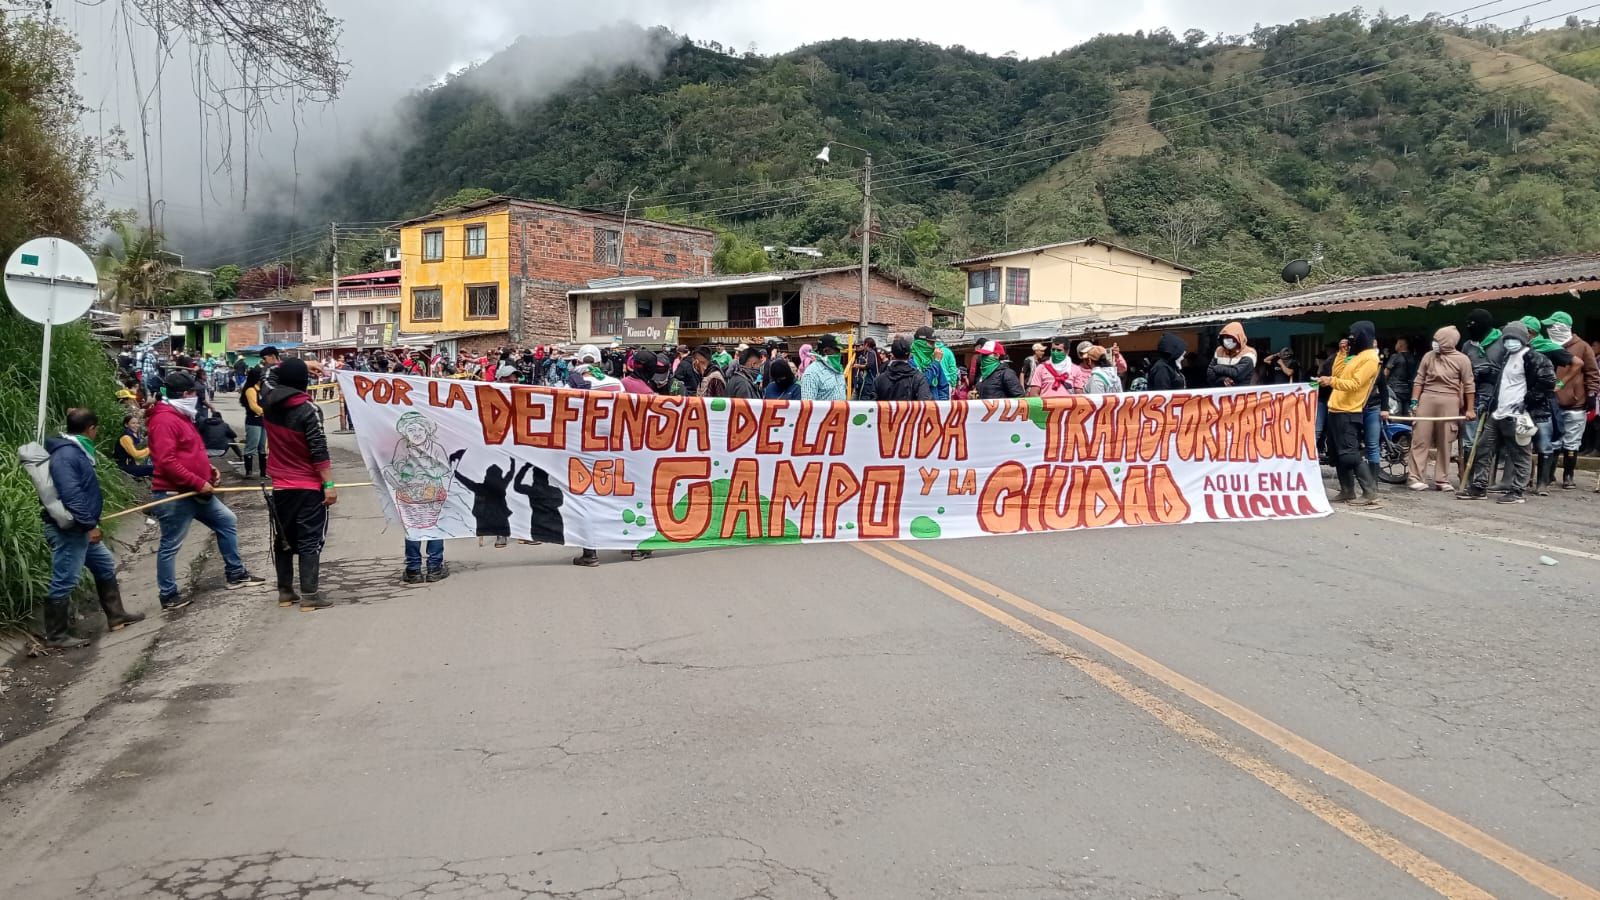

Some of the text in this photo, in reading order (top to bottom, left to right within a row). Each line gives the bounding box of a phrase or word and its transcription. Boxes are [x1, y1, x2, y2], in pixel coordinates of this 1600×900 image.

[353, 375, 413, 406] POR
[428, 381, 472, 411] LA
[475, 384, 710, 452] DEFENSA
[727, 397, 789, 455] DE
[791, 399, 850, 457] LA
[877, 400, 969, 461] VIDA
[980, 399, 998, 421] Y
[999, 399, 1028, 421] LA
[569, 457, 634, 496] DEL
[918, 466, 939, 495] Y
[947, 468, 977, 495] LA
[1203, 471, 1308, 492] AQUI EN LA
